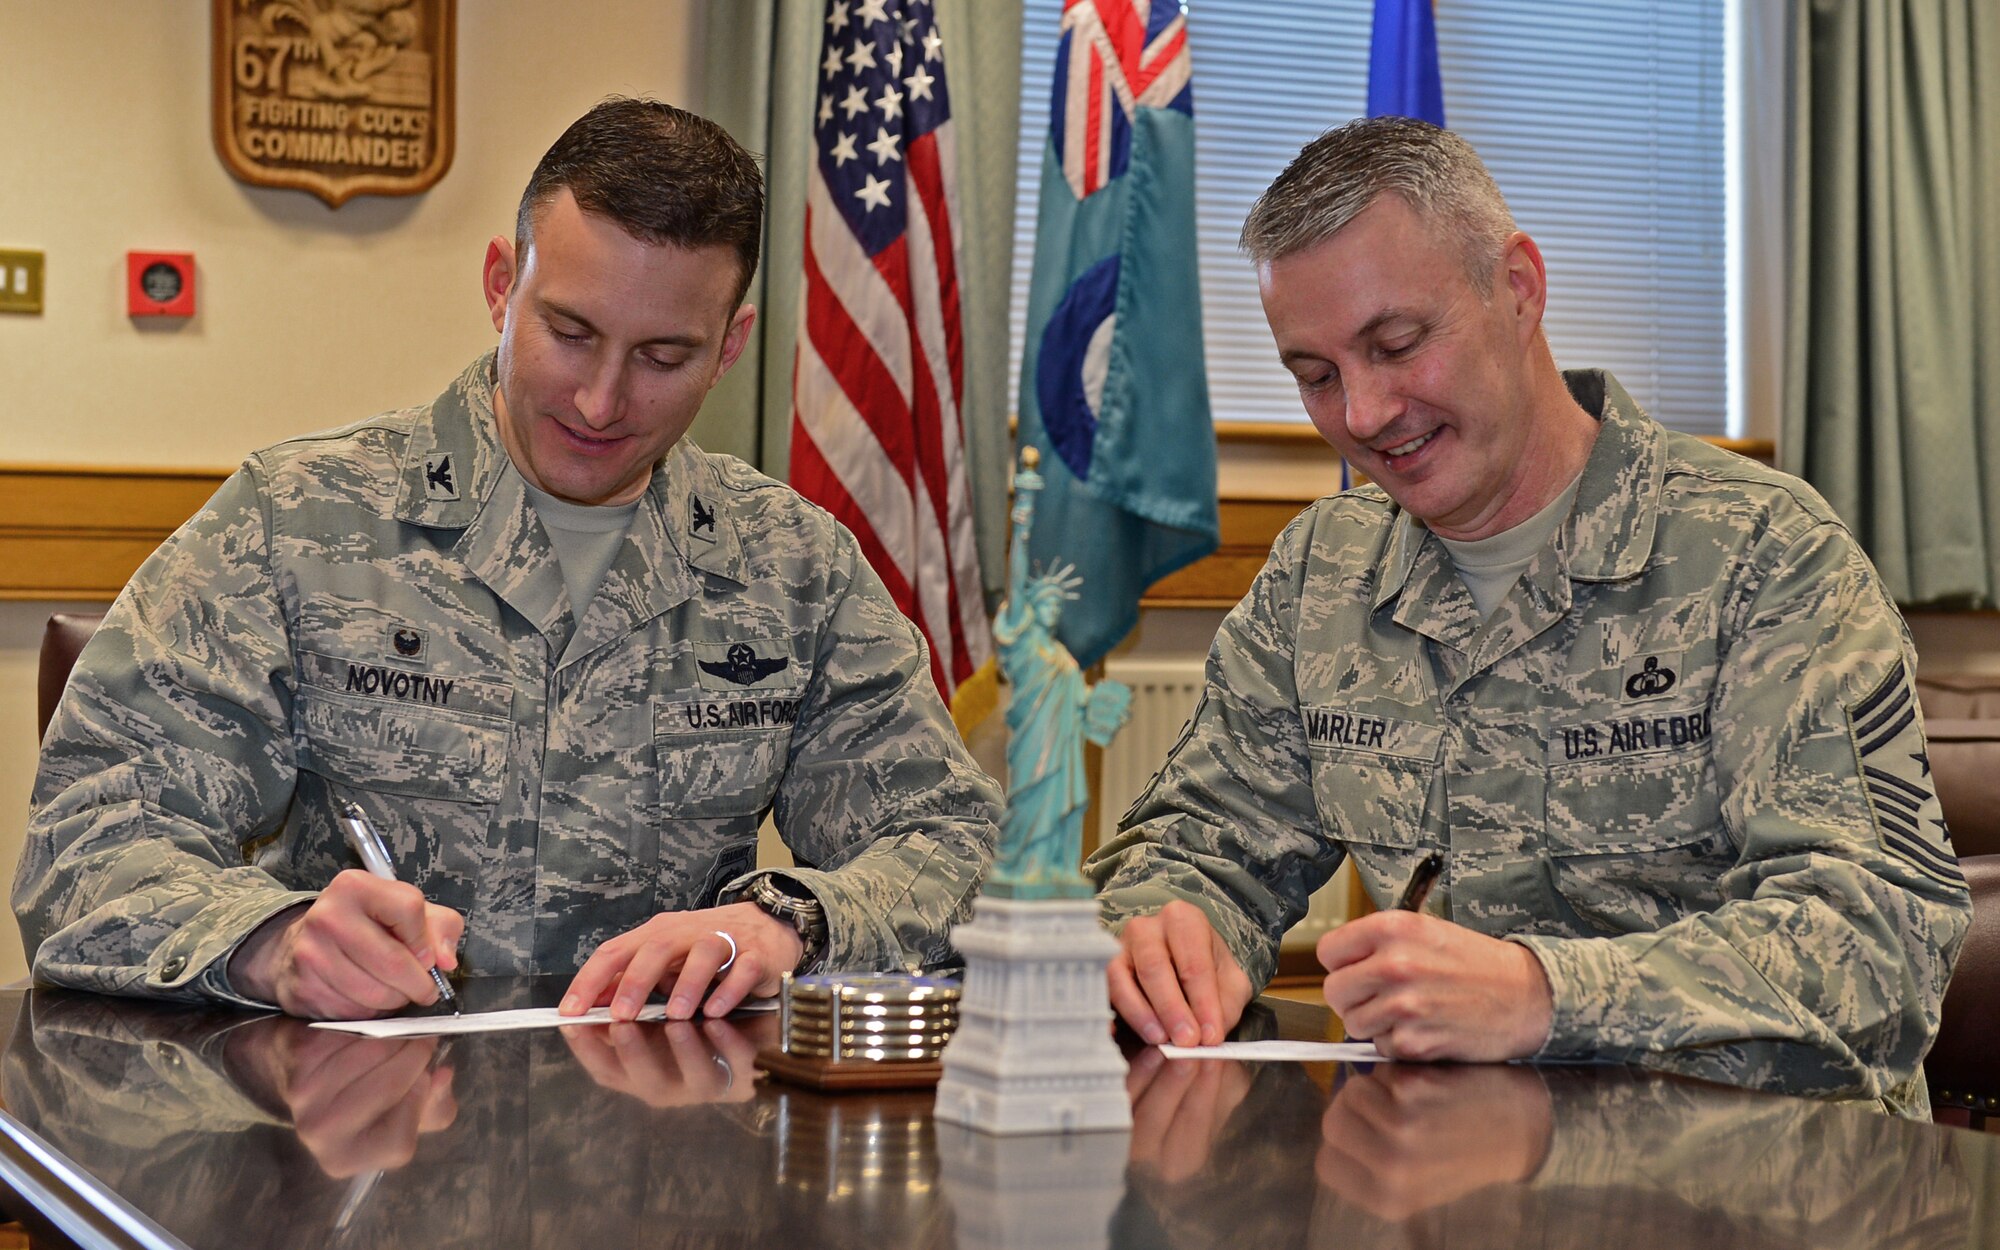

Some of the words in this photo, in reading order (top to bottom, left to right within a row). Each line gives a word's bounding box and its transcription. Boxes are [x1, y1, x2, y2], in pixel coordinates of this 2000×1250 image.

[249, 99, 350, 128] FIGHTING
[359, 106, 428, 135] COCKS
[247, 129, 426, 169] COMMANDER
[346, 665, 454, 704] NOVOTNY
[687, 703, 726, 729] U.S.
[729, 701, 760, 727] AIR
[760, 700, 800, 726] FORC
[1307, 710, 1386, 748] MARLER
[1565, 728, 1603, 760] U.S.
[1609, 720, 1648, 754] AIR
[1653, 706, 1712, 748] FORC
